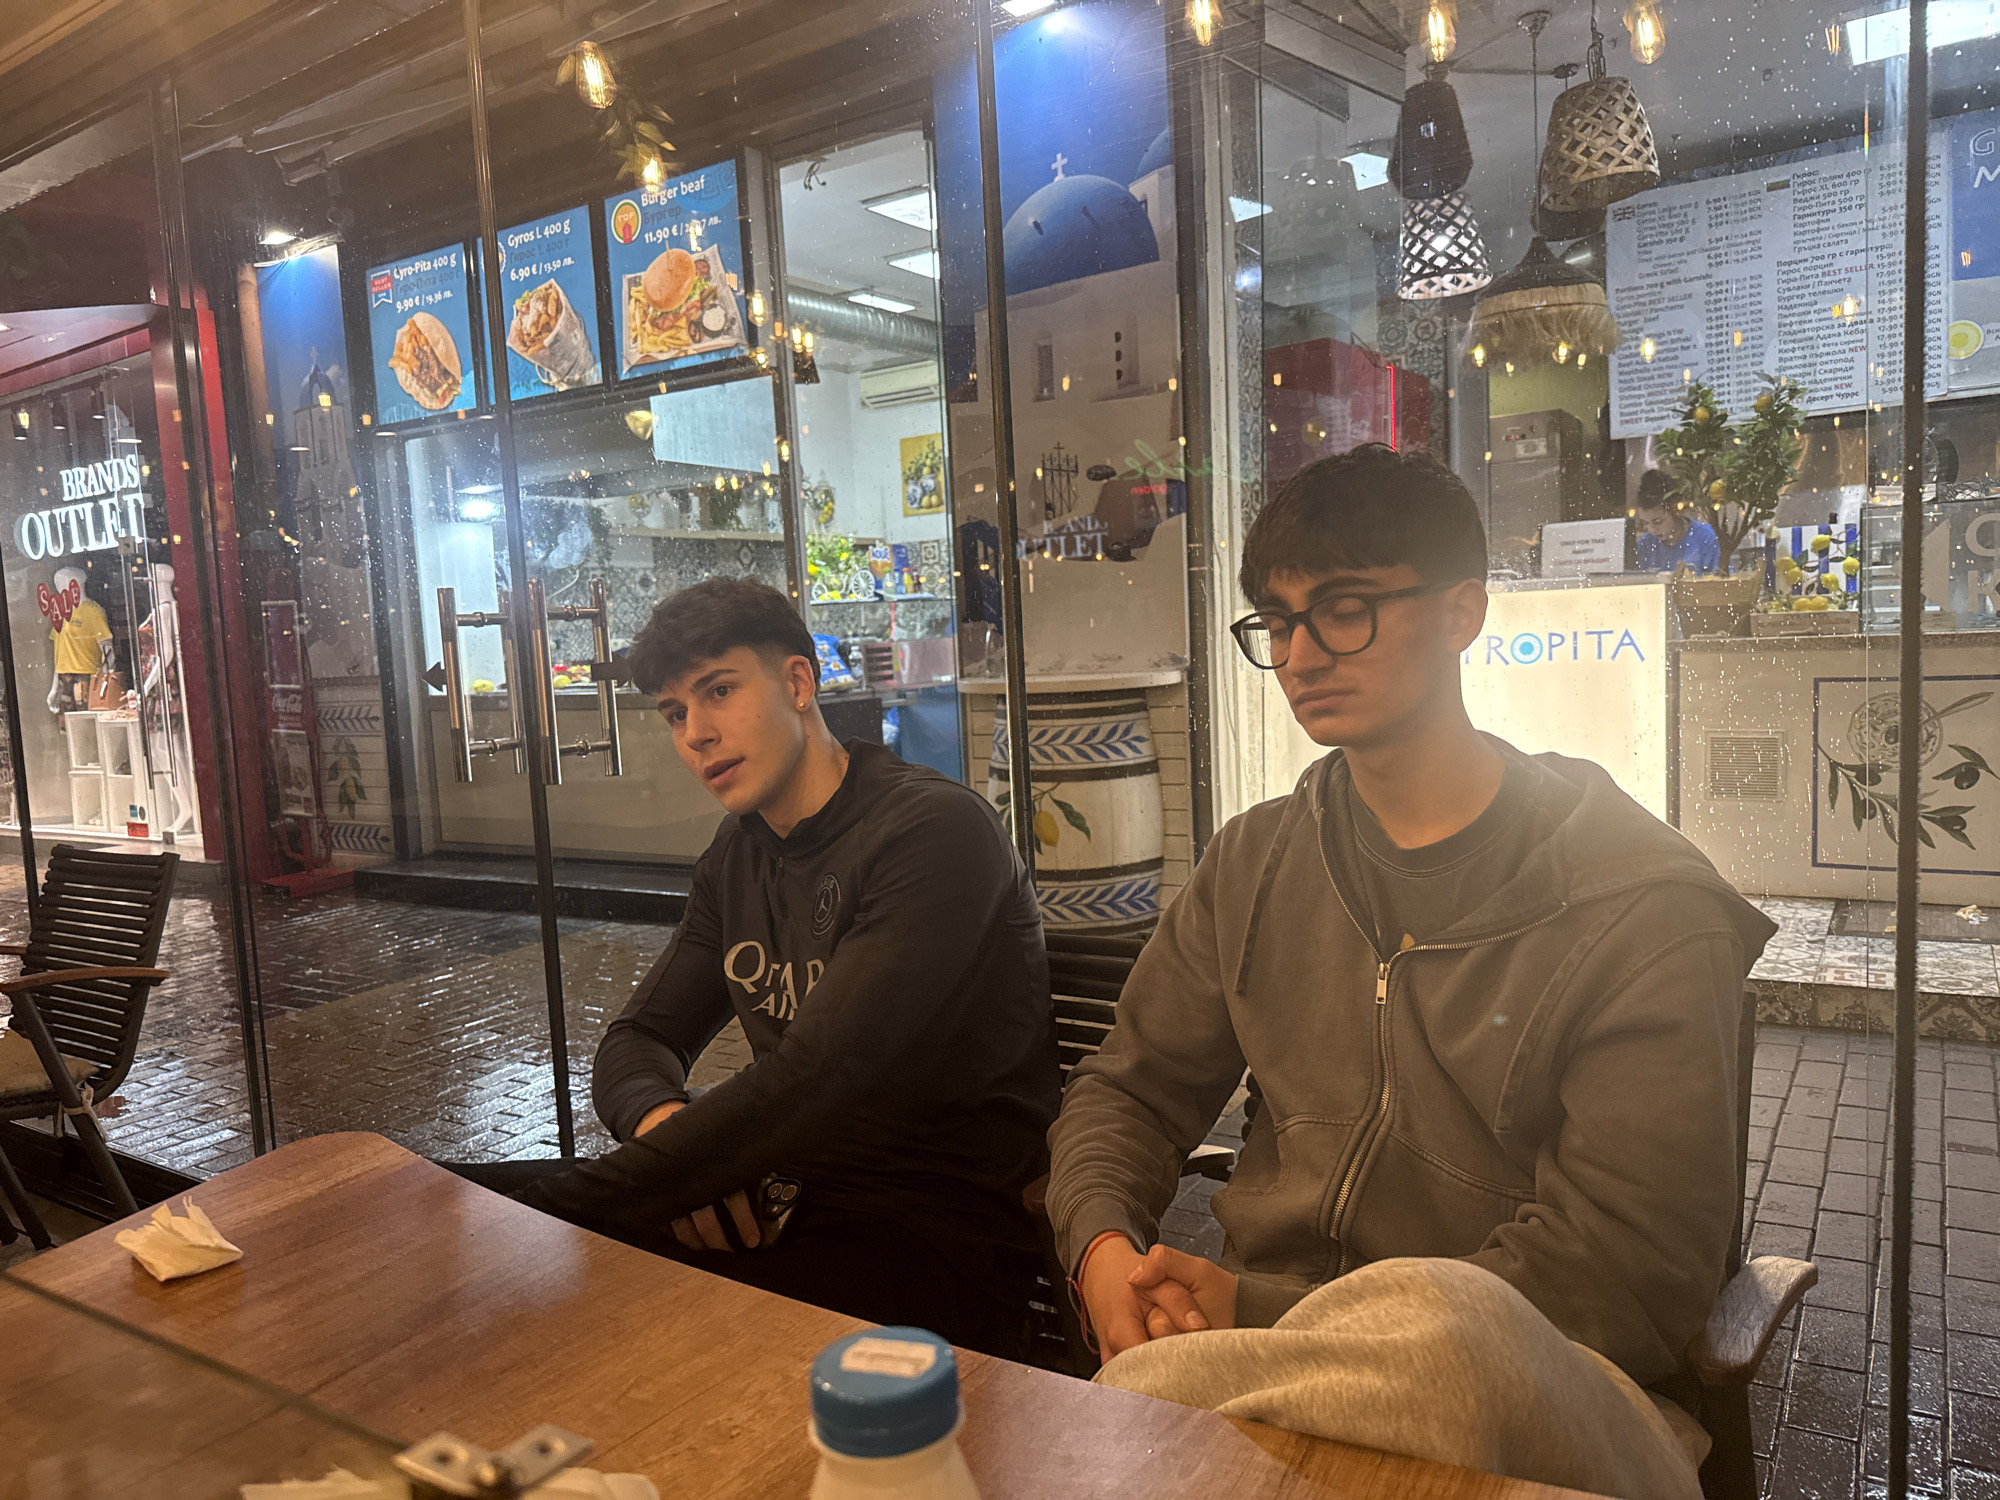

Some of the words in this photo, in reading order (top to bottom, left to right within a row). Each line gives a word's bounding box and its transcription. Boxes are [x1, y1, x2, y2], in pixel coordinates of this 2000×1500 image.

[1880, 163, 1896, 171] 6.90
[1792, 180, 1816, 188] Гирос
[1819, 174, 1844, 182] голям
[1846, 170, 1861, 178] 400
[1880, 172, 1896, 180] 7.90
[1793, 188, 1816, 196] Гирос
[1832, 180, 1847, 188] 600
[1879, 180, 1896, 189] 5.90
[641, 187, 678, 207] Burger
[681, 175, 705, 195] beaf
[1823, 190, 1838, 200] 500
[1878, 188, 1896, 198] 9.90
[1793, 200, 1835, 212] Гиро-Пита
[1838, 196, 1853, 204] 500
[1793, 208, 1836, 220] Гарнитури
[1839, 205, 1852, 214] 350
[1882, 206, 1898, 214] 5.90
[617, 212, 634, 222] TOP
[644, 207, 681, 226] Бургер
[1794, 217, 1830, 229] Картофки
[1882, 221, 1896, 229] 6.90
[508, 231, 534, 248] Gyros
[536, 227, 542, 238] L
[544, 223, 561, 238] 400
[564, 219, 570, 234] g
[644, 227, 669, 243] 11.90
[672, 225, 677, 236] €
[1882, 230, 1898, 239] 9.90
[510, 248, 535, 264] Гирос
[539, 245, 542, 255] L
[546, 241, 562, 254] 400
[566, 238, 570, 247] г
[1794, 244, 1820, 254] Гръцка
[1823, 240, 1848, 248] салата
[433, 256, 448, 270] 400
[450, 253, 456, 267] g
[1876, 252, 1895, 260] 15.90
[1777, 258, 1808, 267] Порции
[1878, 261, 1897, 269] 15.90
[510, 267, 530, 282] 6.90
[532, 264, 537, 274] €
[544, 260, 561, 273] 13.50
[563, 257, 574, 266] лв.
[1777, 268, 1800, 276] Гирос
[1804, 262, 1833, 272] порция
[1777, 274, 1819, 285] Гиро-Пита
[1822, 268, 1842, 277] BEST
[1844, 264, 1874, 274] SELLER
[1877, 270, 1896, 278] 17.90
[395, 277, 436, 295] Гиро-Пита
[439, 272, 453, 284] 400
[1777, 284, 1810, 294] Сувлаки
[1818, 276, 1851, 286] Панчета
[1778, 292, 1806, 302] Бургер
[1808, 288, 1843, 297] телешки
[1878, 288, 1897, 296] 15.90
[396, 299, 413, 313] 9.90
[415, 297, 420, 305] €
[426, 292, 442, 304] 19.36
[443, 290, 453, 298] лв.
[1778, 300, 1818, 311] Наденица
[1878, 296, 1897, 305] 14.90
[1778, 308, 1811, 320] Пилешки
[1878, 306, 1897, 314] 17.90
[1778, 317, 1812, 328] Бифтеки
[1877, 315, 1897, 323] 29.90
[1778, 324, 1834, 336] Гладиаторска
[1878, 324, 1897, 332] 17.90
[1778, 336, 1814, 345] Телешки
[1816, 332, 1841, 340] Адана
[1878, 333, 1896, 341] 17.90
[1778, 344, 1814, 354] Кюфтета
[1880, 342, 1898, 350] 15.90
[1779, 354, 1807, 364] Вратна
[1809, 350, 1846, 359] пържола
[1877, 351, 1896, 359] 19.90
[1819, 356, 1854, 366] октопод
[1818, 366, 1854, 375] Скариди
[1808, 374, 1852, 385] наденички
[1874, 378, 1895, 386] 25.90
[1834, 382, 1852, 390] NEW
[1806, 394, 1834, 404] Десерт
[60, 454, 139, 501] BRANDS
[22, 493, 144, 560] OUTLET
[40, 586, 79, 622] SALE
